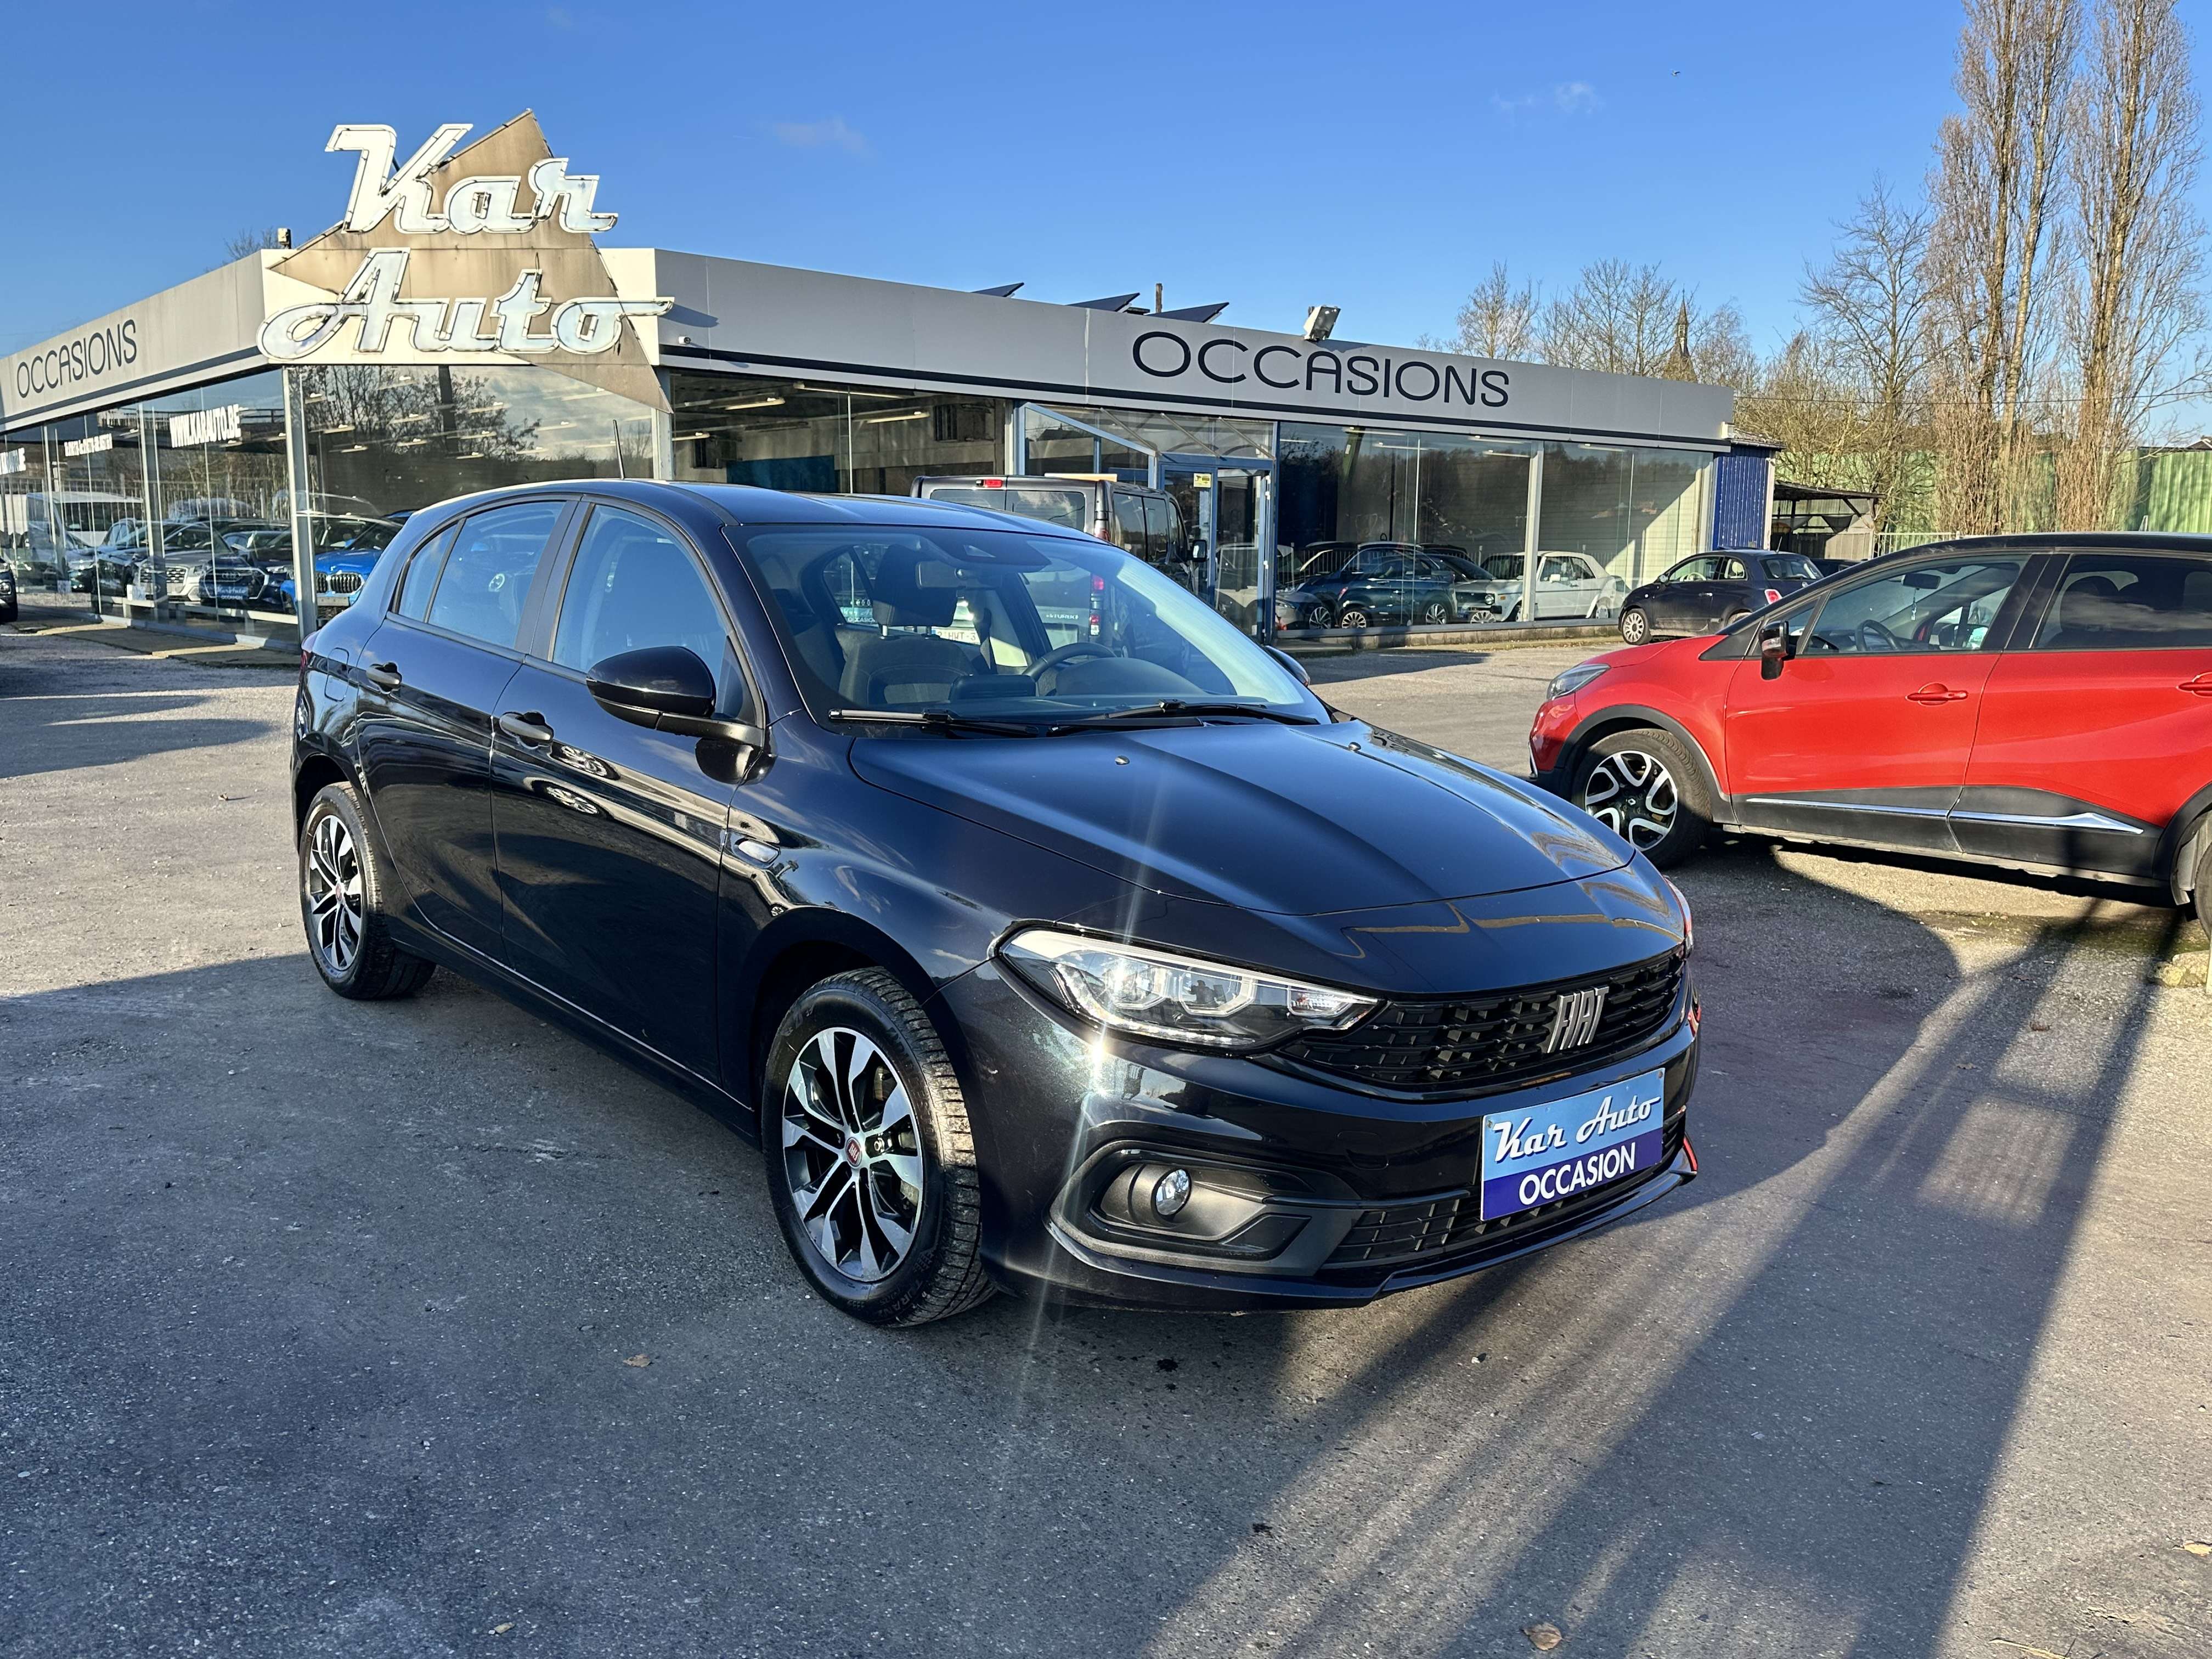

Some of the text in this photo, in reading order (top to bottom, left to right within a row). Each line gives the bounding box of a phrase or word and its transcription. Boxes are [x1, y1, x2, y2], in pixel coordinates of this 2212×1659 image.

[325, 123, 618, 235] Kar
[256, 247, 675, 359] Auto
[17, 319, 137, 398] OCCASIONS
[1133, 331, 1509, 407] OCCASIONS
[1547, 986, 1609, 1053] FIAT
[1492, 1096, 1661, 1163] Kar Auto
[1519, 1142, 1636, 1205] OCCASION
